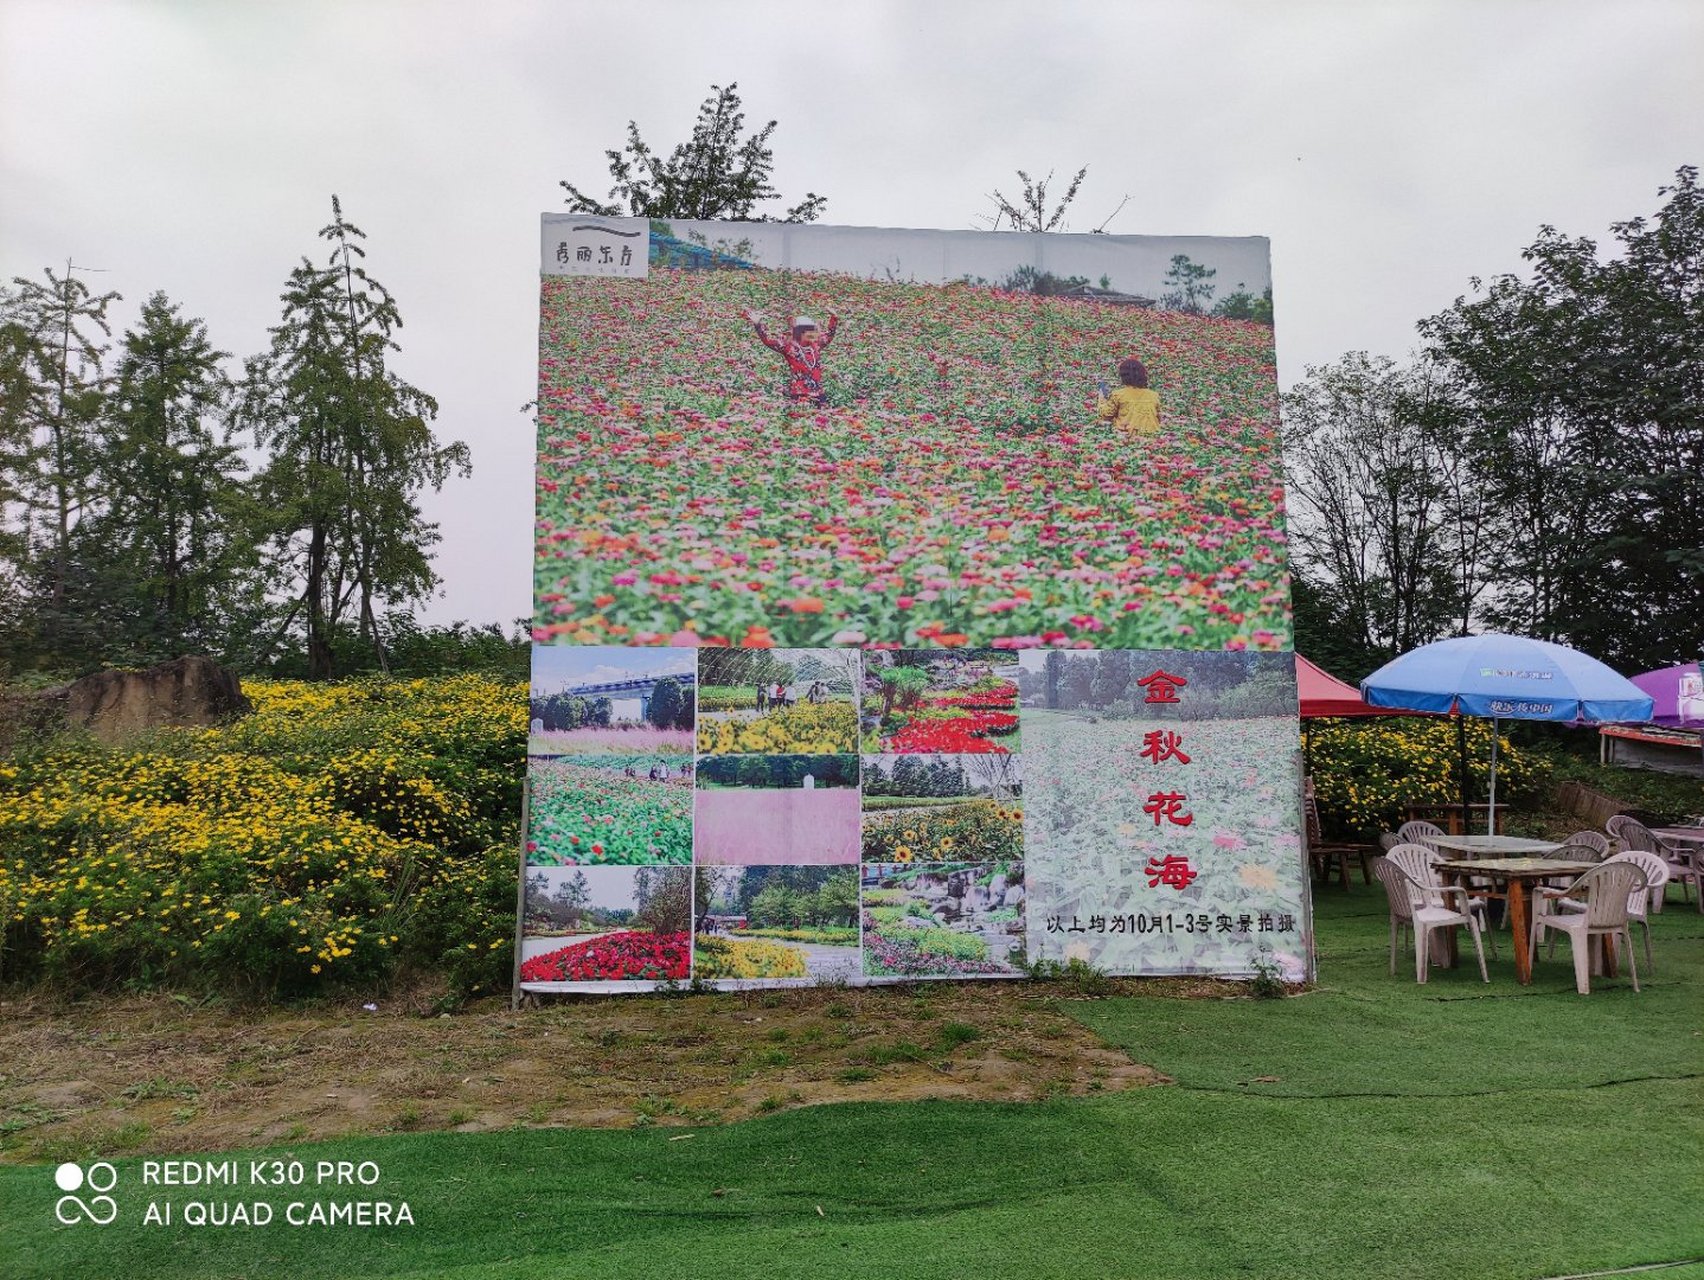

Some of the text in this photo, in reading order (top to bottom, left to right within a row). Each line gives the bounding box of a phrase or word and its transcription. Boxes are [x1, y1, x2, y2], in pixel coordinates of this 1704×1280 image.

[1137, 668, 1198, 891] 金秋花海
[1046, 912, 1297, 934] 以上均为10月1-3号实景拍摄
